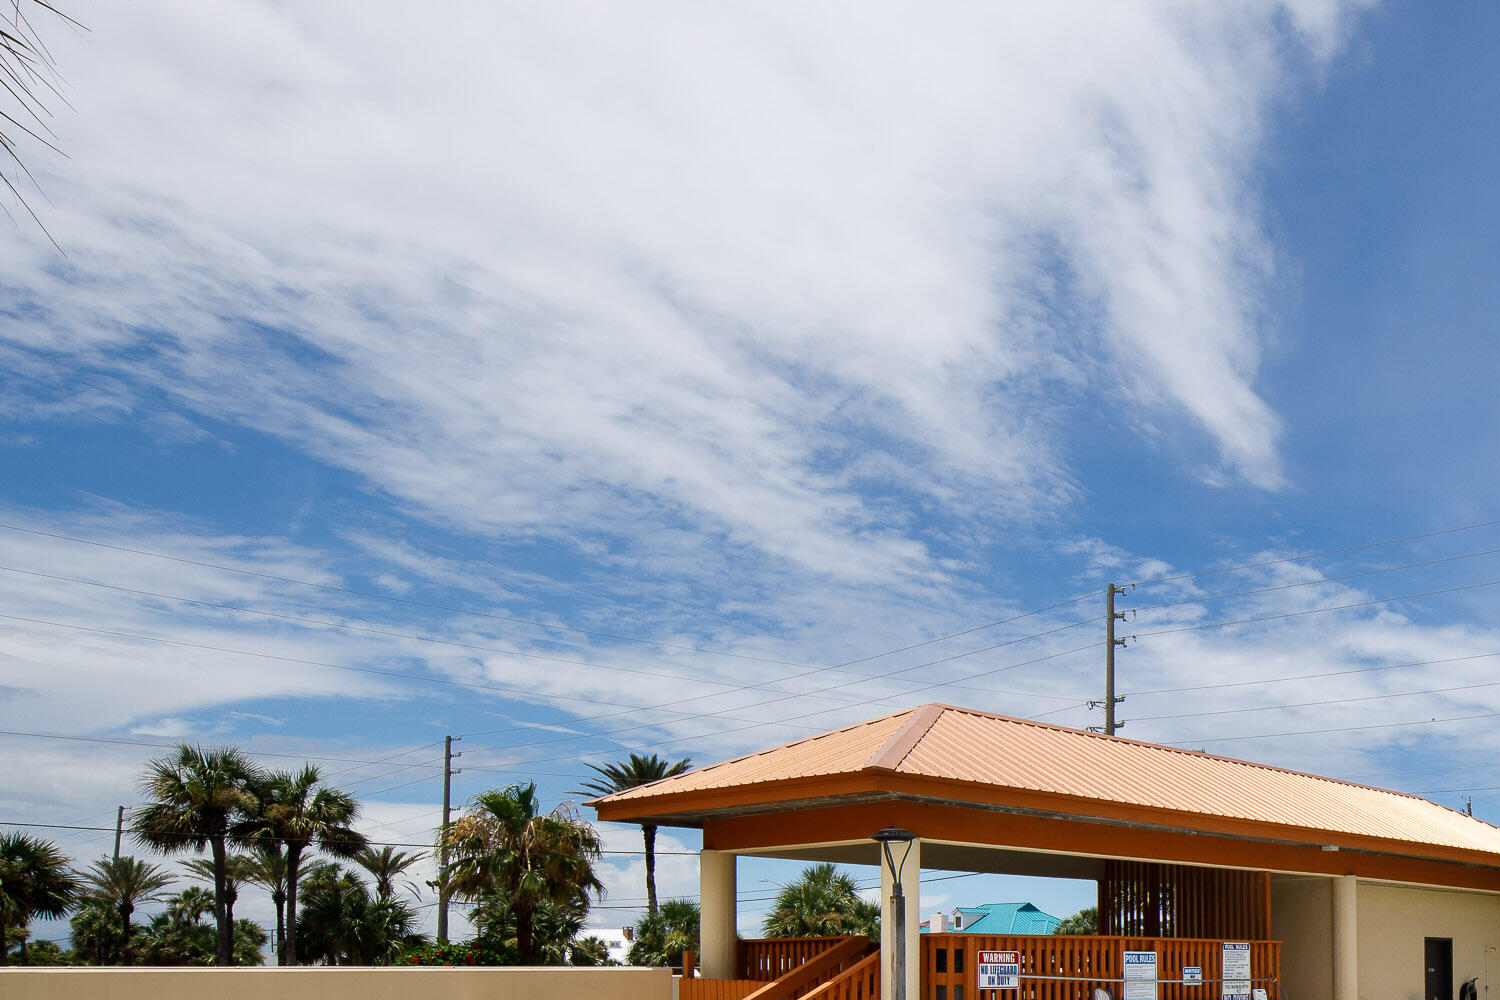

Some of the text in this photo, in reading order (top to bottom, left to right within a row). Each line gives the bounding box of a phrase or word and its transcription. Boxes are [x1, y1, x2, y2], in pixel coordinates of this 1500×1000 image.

[983, 953, 1015, 962] WARNING
[981, 966, 1017, 975] NO LIFEGUARD
[988, 976, 1010, 985] ON DUTY
